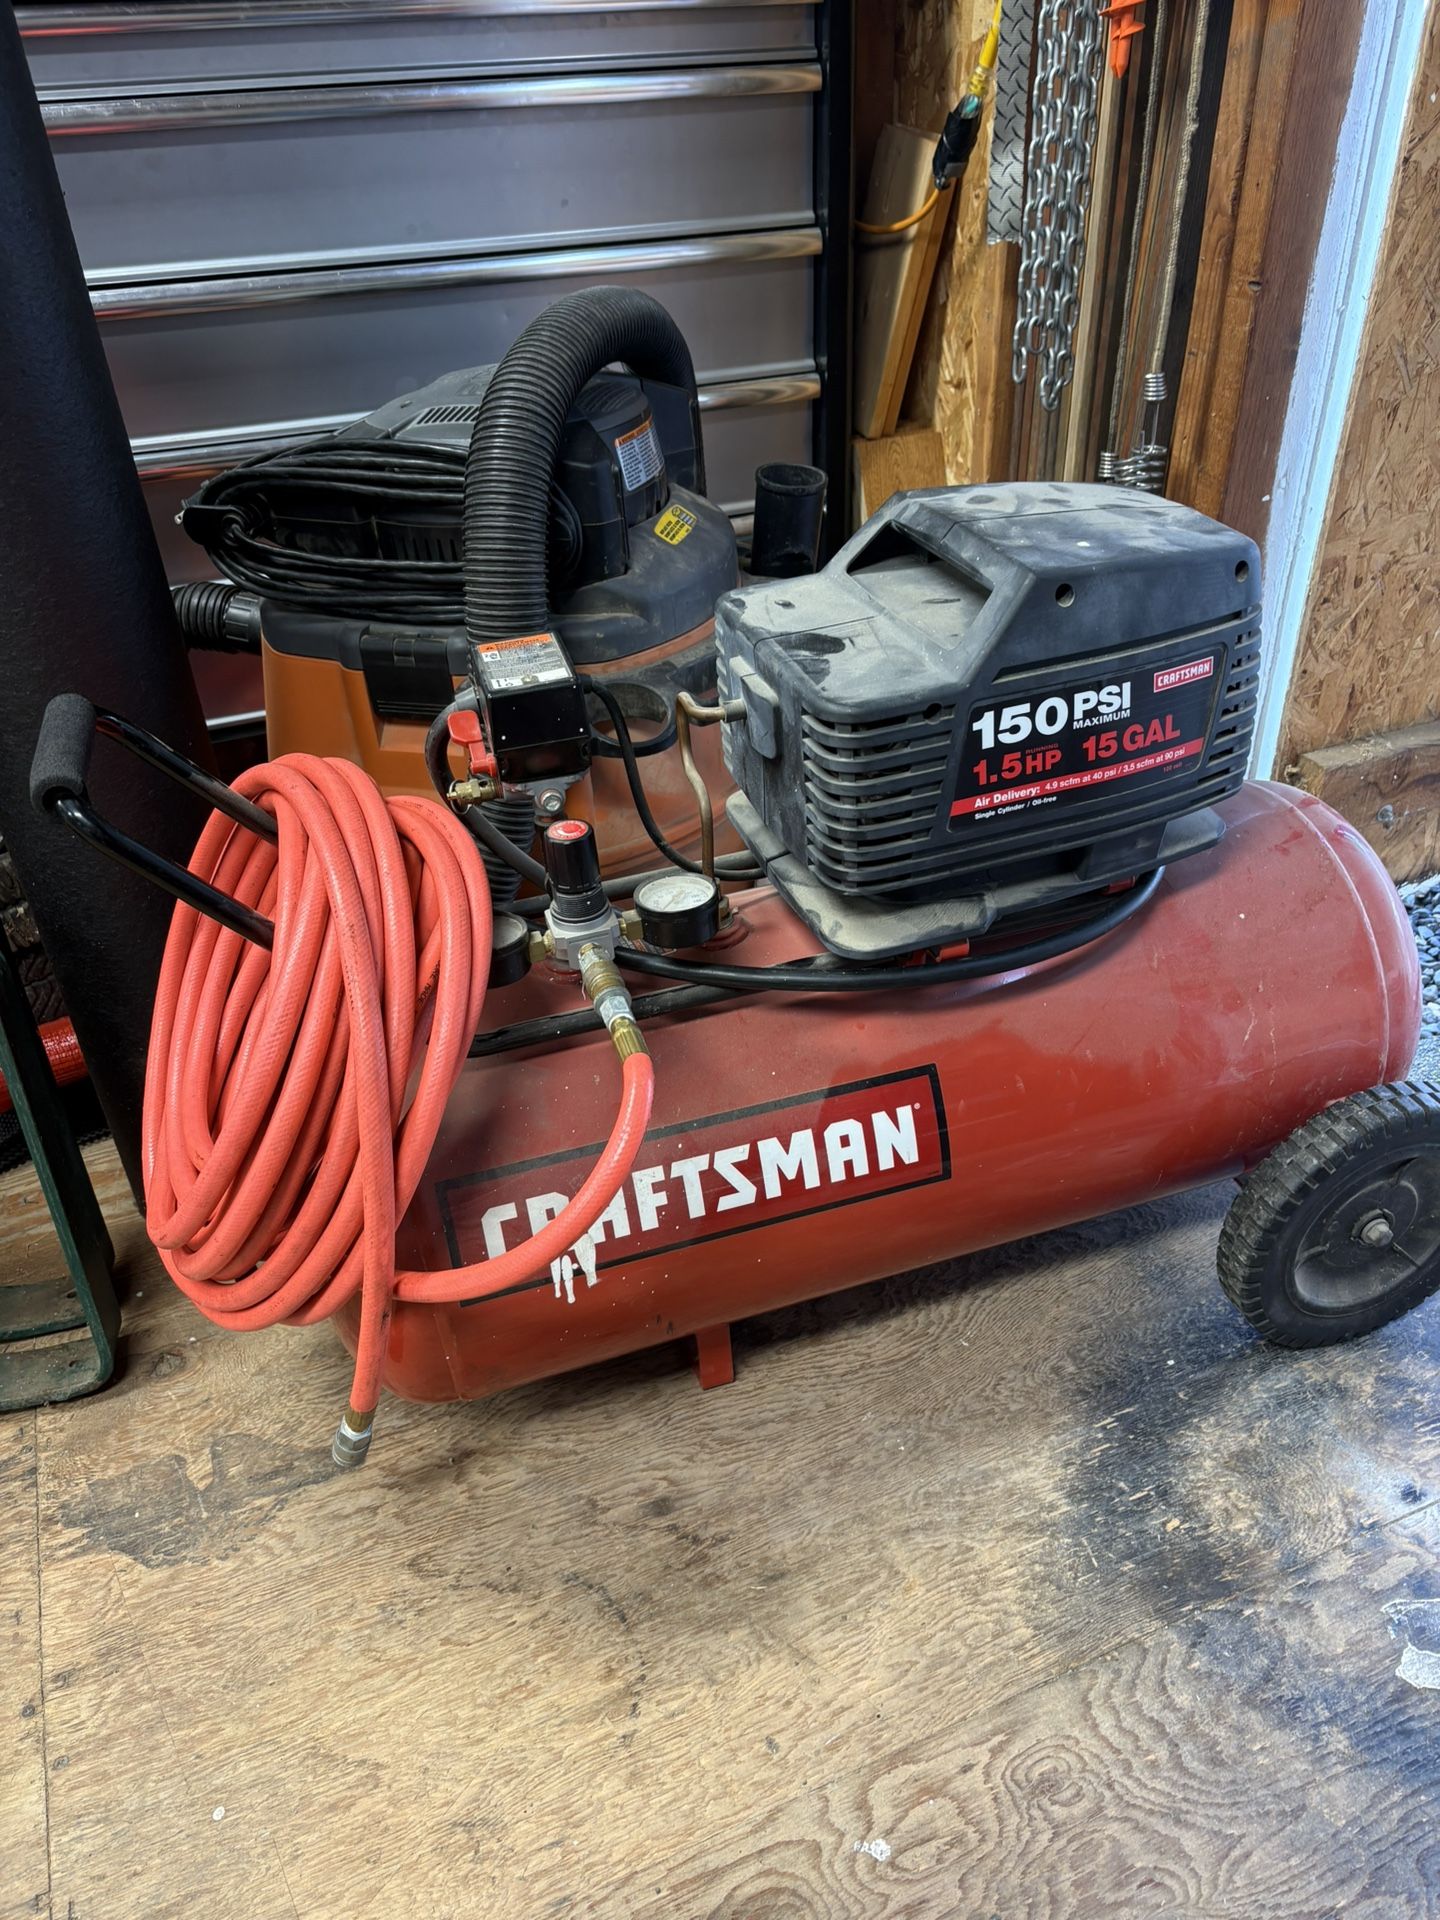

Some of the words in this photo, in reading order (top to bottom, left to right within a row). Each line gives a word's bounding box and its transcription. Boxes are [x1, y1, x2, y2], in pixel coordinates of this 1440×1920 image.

[1158, 662, 1210, 686] CRAFTSMAN
[972, 697, 1069, 750] 150
[1073, 681, 1132, 720] PSI
[1073, 709, 1131, 730] MAXIMUM
[1083, 730, 1118, 761] 15
[1123, 714, 1181, 752] GAL
[973, 752, 1023, 785] 1.5
[1026, 749, 1062, 775] HP
[974, 797, 990, 808] Air
[993, 785, 1041, 803] Delivery:
[1045, 781, 1058, 790] 4.9
[1060, 776, 1081, 787] scfm
[1082, 774, 1091, 783] at
[1093, 771, 1103, 780] 40
[1104, 767, 1117, 779] psi
[1117, 765, 1123, 775] /
[1123, 763, 1135, 773] 3.5
[1136, 758, 1155, 769] scfm
[1156, 754, 1164, 763] at
[1164, 751, 1174, 760] 90
[1174, 747, 1186, 759] psi
[974, 809, 996, 820] Single
[997, 802, 1026, 815] Cylinder
